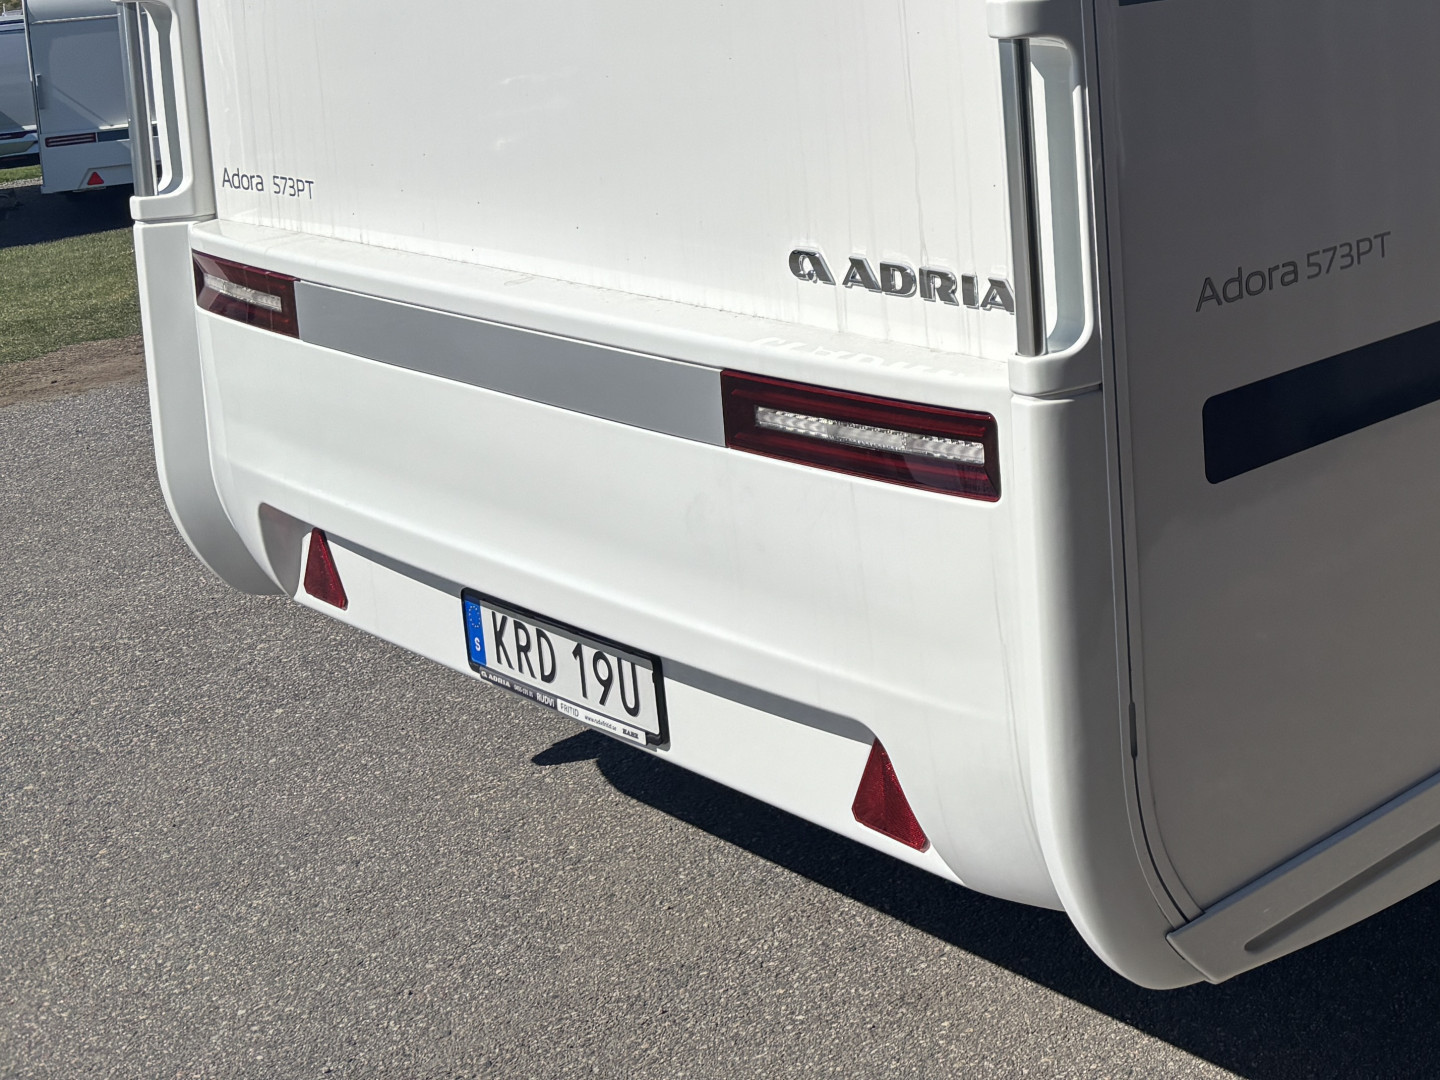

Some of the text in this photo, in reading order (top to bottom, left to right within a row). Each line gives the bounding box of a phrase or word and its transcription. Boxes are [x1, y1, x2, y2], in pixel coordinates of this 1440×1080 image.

[222, 167, 314, 199] Adora 573PT
[842, 254, 1016, 315] ADRIA
[1195, 231, 1392, 313] Adora 573PT
[474, 636, 481, 652] S
[491, 610, 641, 718] KRD 19U
[488, 673, 511, 688] ADRIA
[536, 692, 555, 708] RUDVI
[560, 702, 579, 718] FRITID
